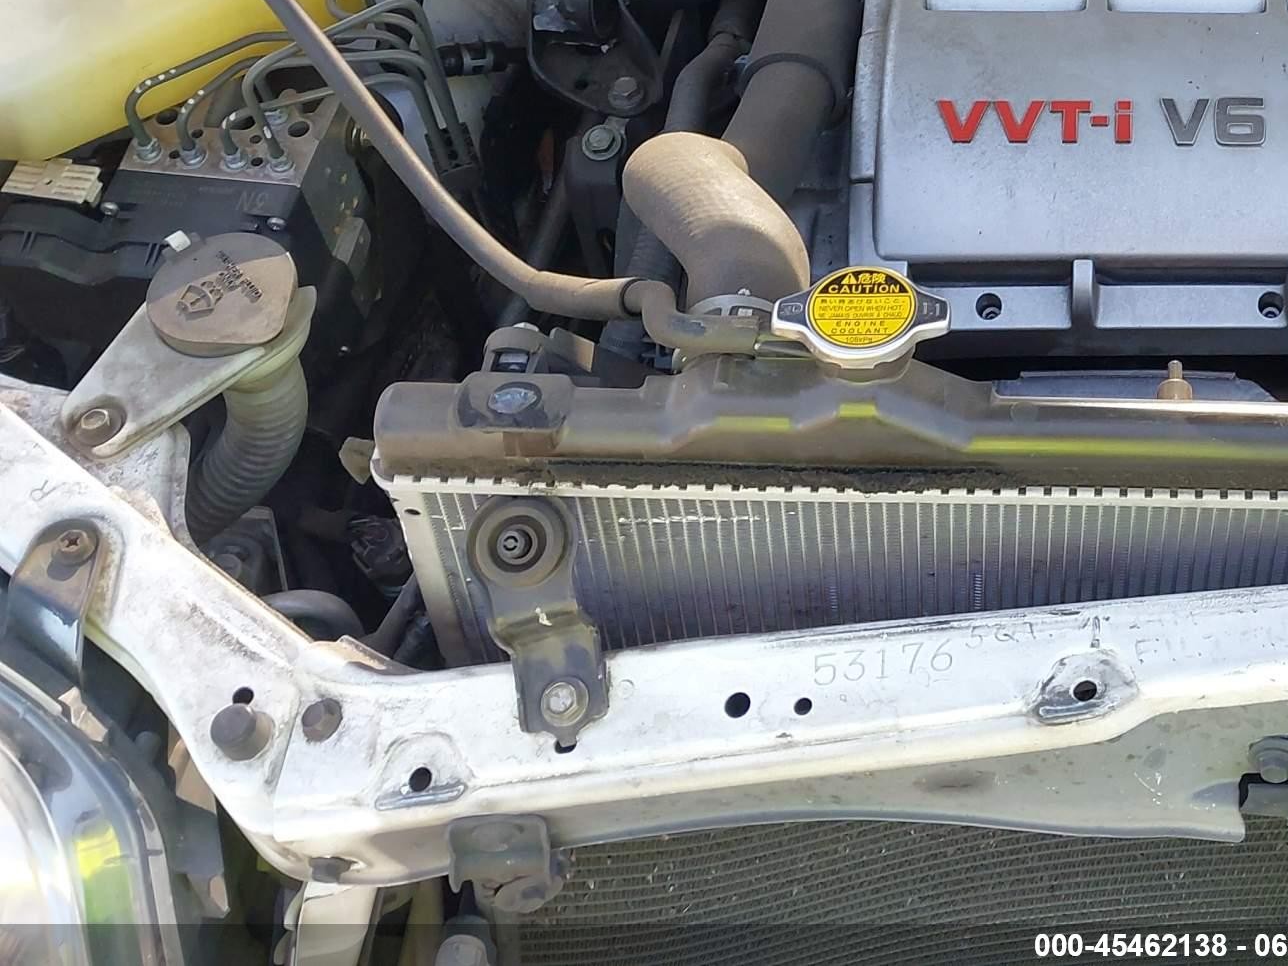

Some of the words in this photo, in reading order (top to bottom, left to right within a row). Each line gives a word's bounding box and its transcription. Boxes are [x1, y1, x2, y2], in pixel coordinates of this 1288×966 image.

[936, 99, 1134, 144] VVT-i
[1160, 97, 1266, 146] V6
[828, 284, 901, 294] CAUTION
[813, 638, 955, 687] 53176
